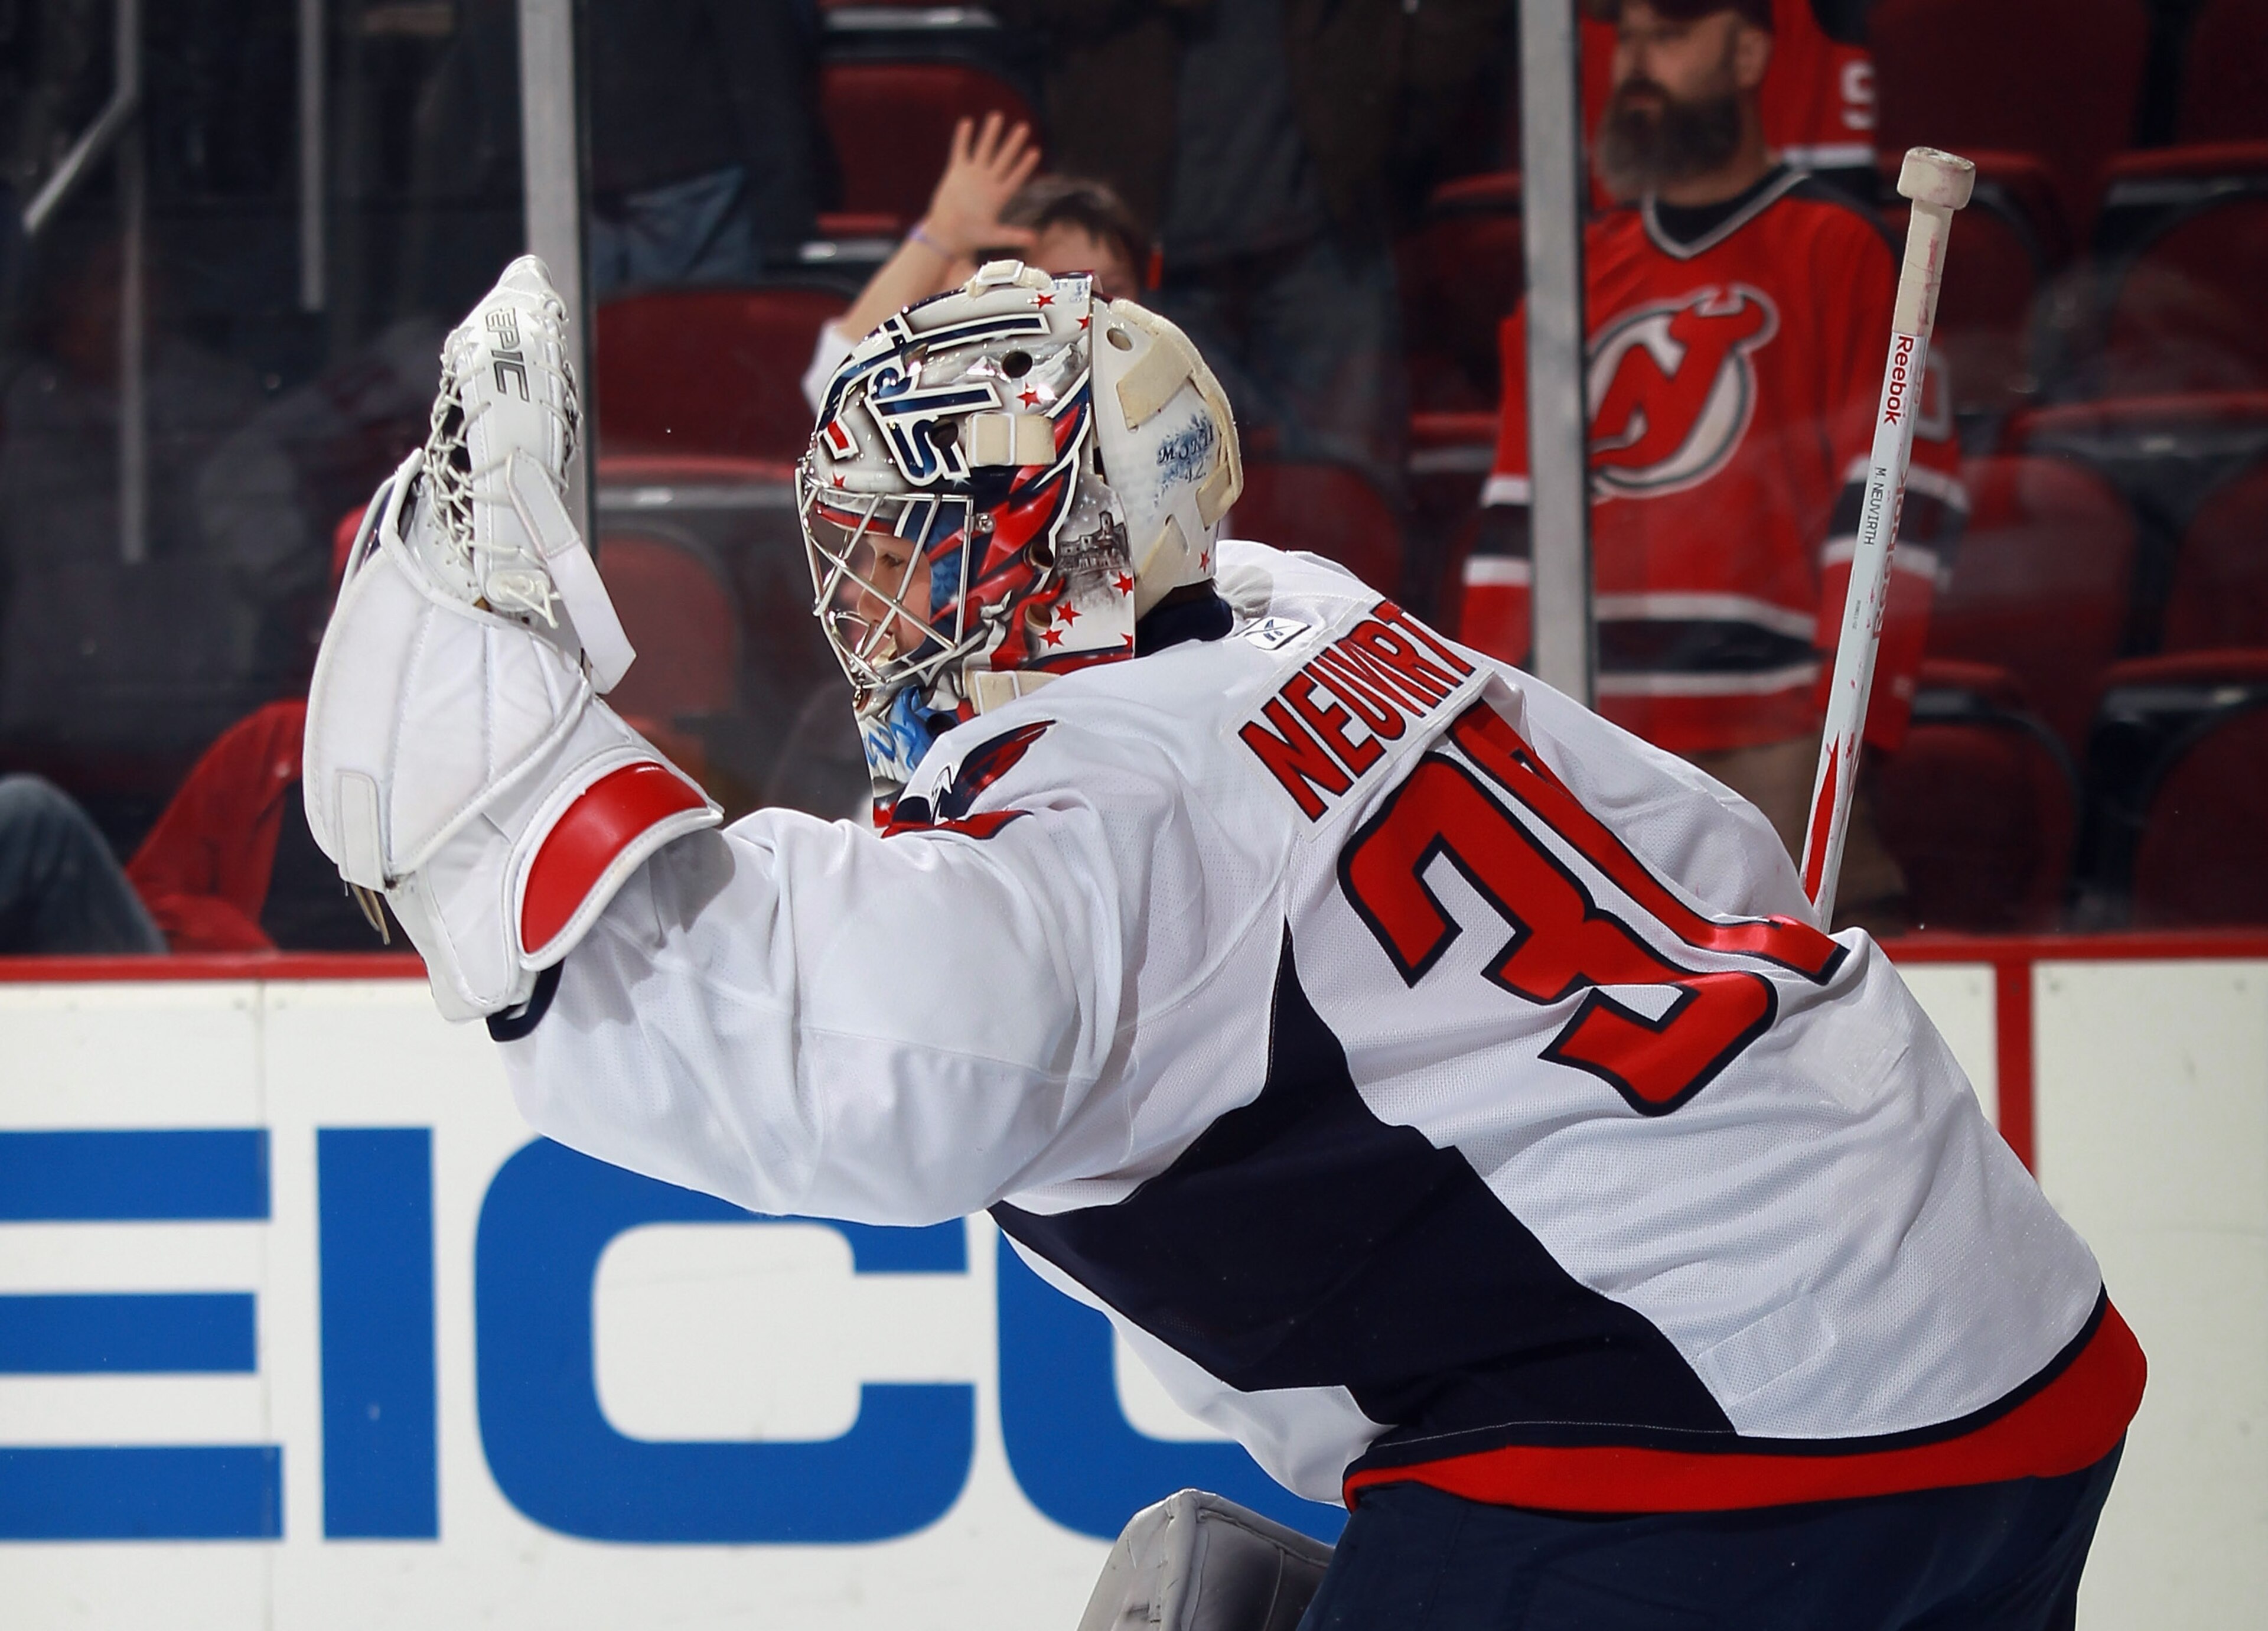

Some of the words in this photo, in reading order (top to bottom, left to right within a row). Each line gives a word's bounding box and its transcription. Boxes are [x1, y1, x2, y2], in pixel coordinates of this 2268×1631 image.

[485, 307, 530, 403] EPIC
[1883, 334, 1915, 427] Reebok
[1874, 467, 1887, 479] M.
[1863, 481, 1885, 546] NEUVIRTH
